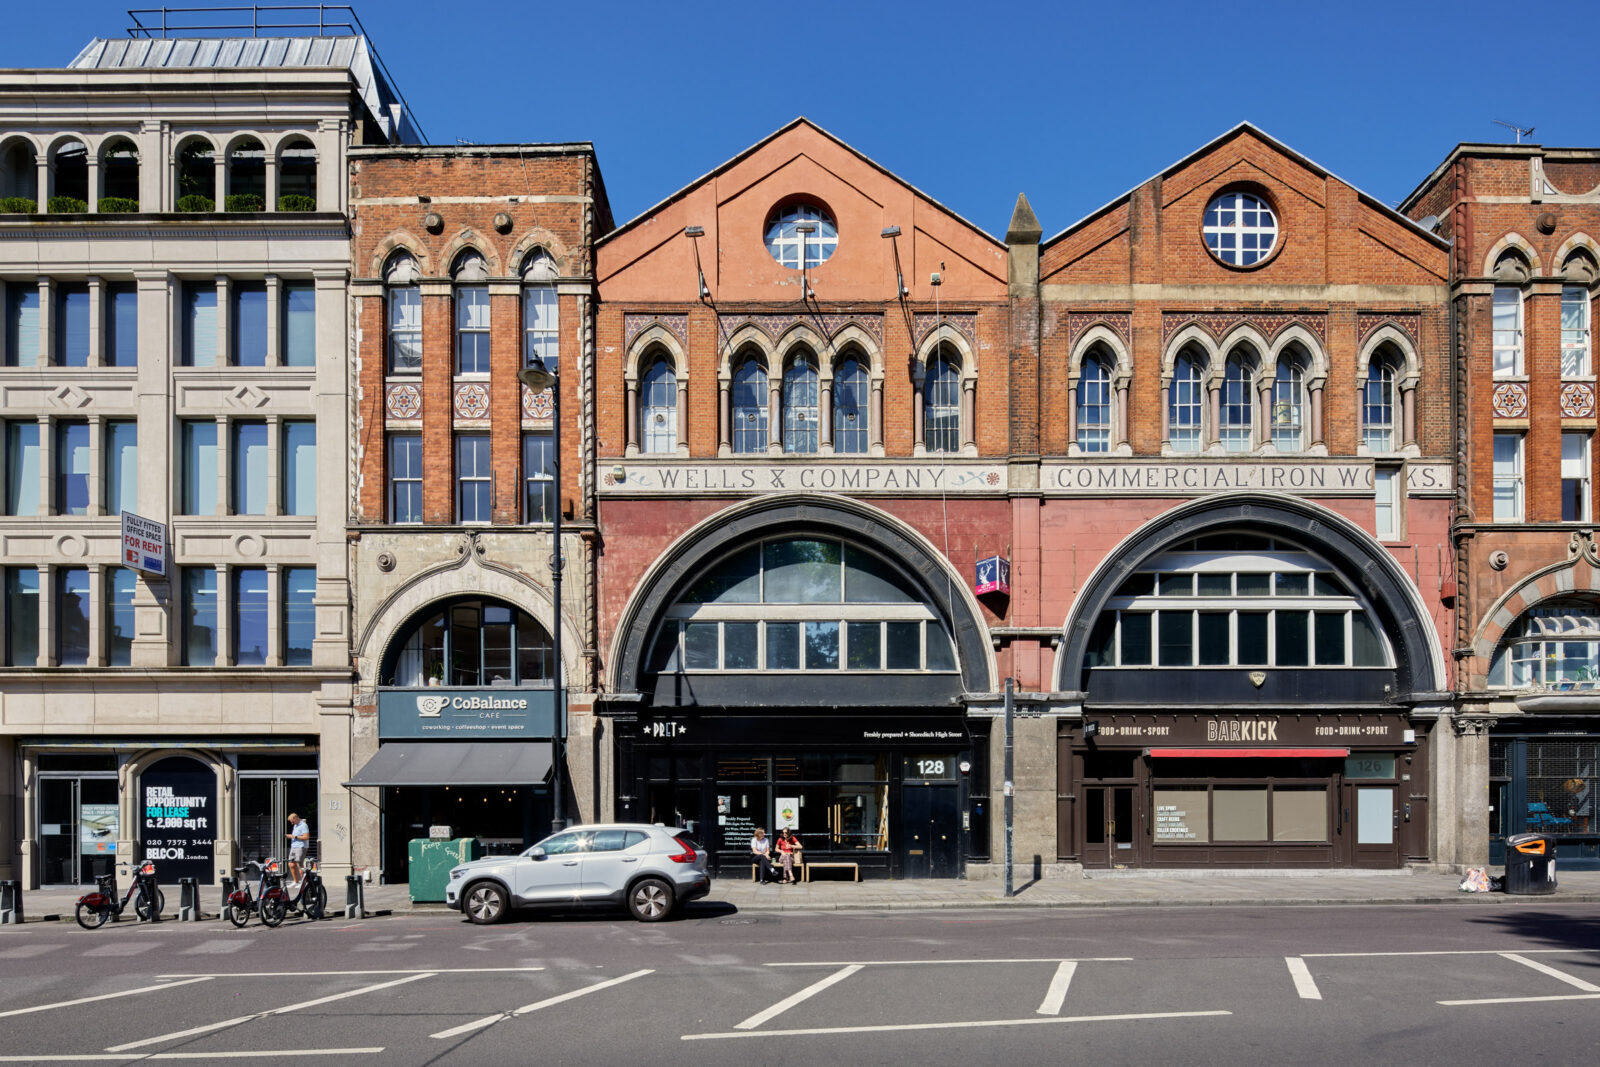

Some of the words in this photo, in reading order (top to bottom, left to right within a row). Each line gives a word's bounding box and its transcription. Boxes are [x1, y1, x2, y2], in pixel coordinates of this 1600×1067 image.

[658, 469, 755, 488] WELLS
[801, 468, 946, 488] COMPANY
[1057, 467, 1249, 488] COMMERCIAL
[1261, 467, 1325, 487] IRON
[1338, 467, 1443, 487] WKS.
[126, 516, 142, 527] FULLY
[143, 521, 161, 533] FITTED
[126, 525, 145, 538] OFFICE
[145, 530, 161, 542] SPACE
[125, 535, 140, 548] FOR
[142, 541, 163, 555] RENT
[452, 696, 527, 710] CoBalance
[455, 723, 486, 731] coffeeshop
[653, 721, 677, 737] PRET
[1120, 726, 1142, 736] DRINK
[1147, 726, 1170, 736] SPORT
[1207, 720, 1278, 741] BARKICK
[1315, 726, 1334, 736] FOOD
[1339, 726, 1361, 735] DRINK
[1366, 725, 1389, 735] SPORT
[864, 731, 881, 739] Freshly
[881, 731, 904, 739] prepared
[935, 731, 948, 739] High
[917, 760, 944, 774] 128
[1357, 760, 1382, 772] 126
[146, 786, 174, 797] RETAIL
[146, 796, 207, 808] OPPORTUNITY
[146, 807, 163, 818] FOR
[164, 807, 189, 818] LEASE
[146, 818, 156, 828] c.
[156, 817, 183, 829] 2,000
[183, 818, 196, 831] sq
[197, 817, 207, 828] ft
